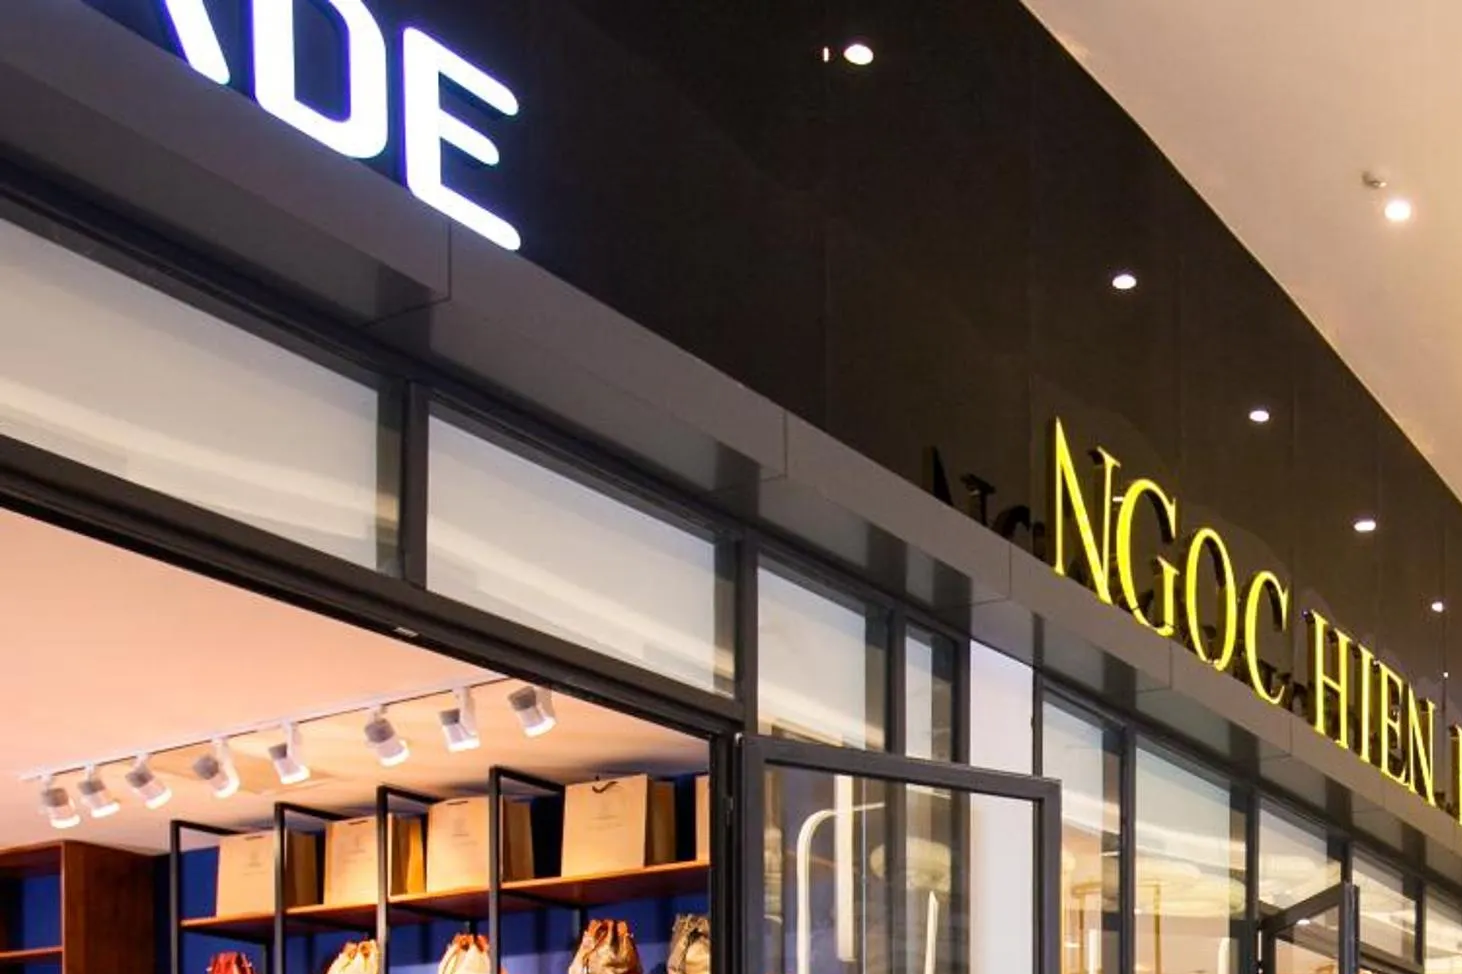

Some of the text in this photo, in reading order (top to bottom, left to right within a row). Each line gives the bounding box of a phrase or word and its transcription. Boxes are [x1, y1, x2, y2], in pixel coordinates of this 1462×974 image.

[163, 0, 521, 251] DE
[1052, 416, 1289, 705] NGOC
[1311, 610, 1436, 806] HIEN
